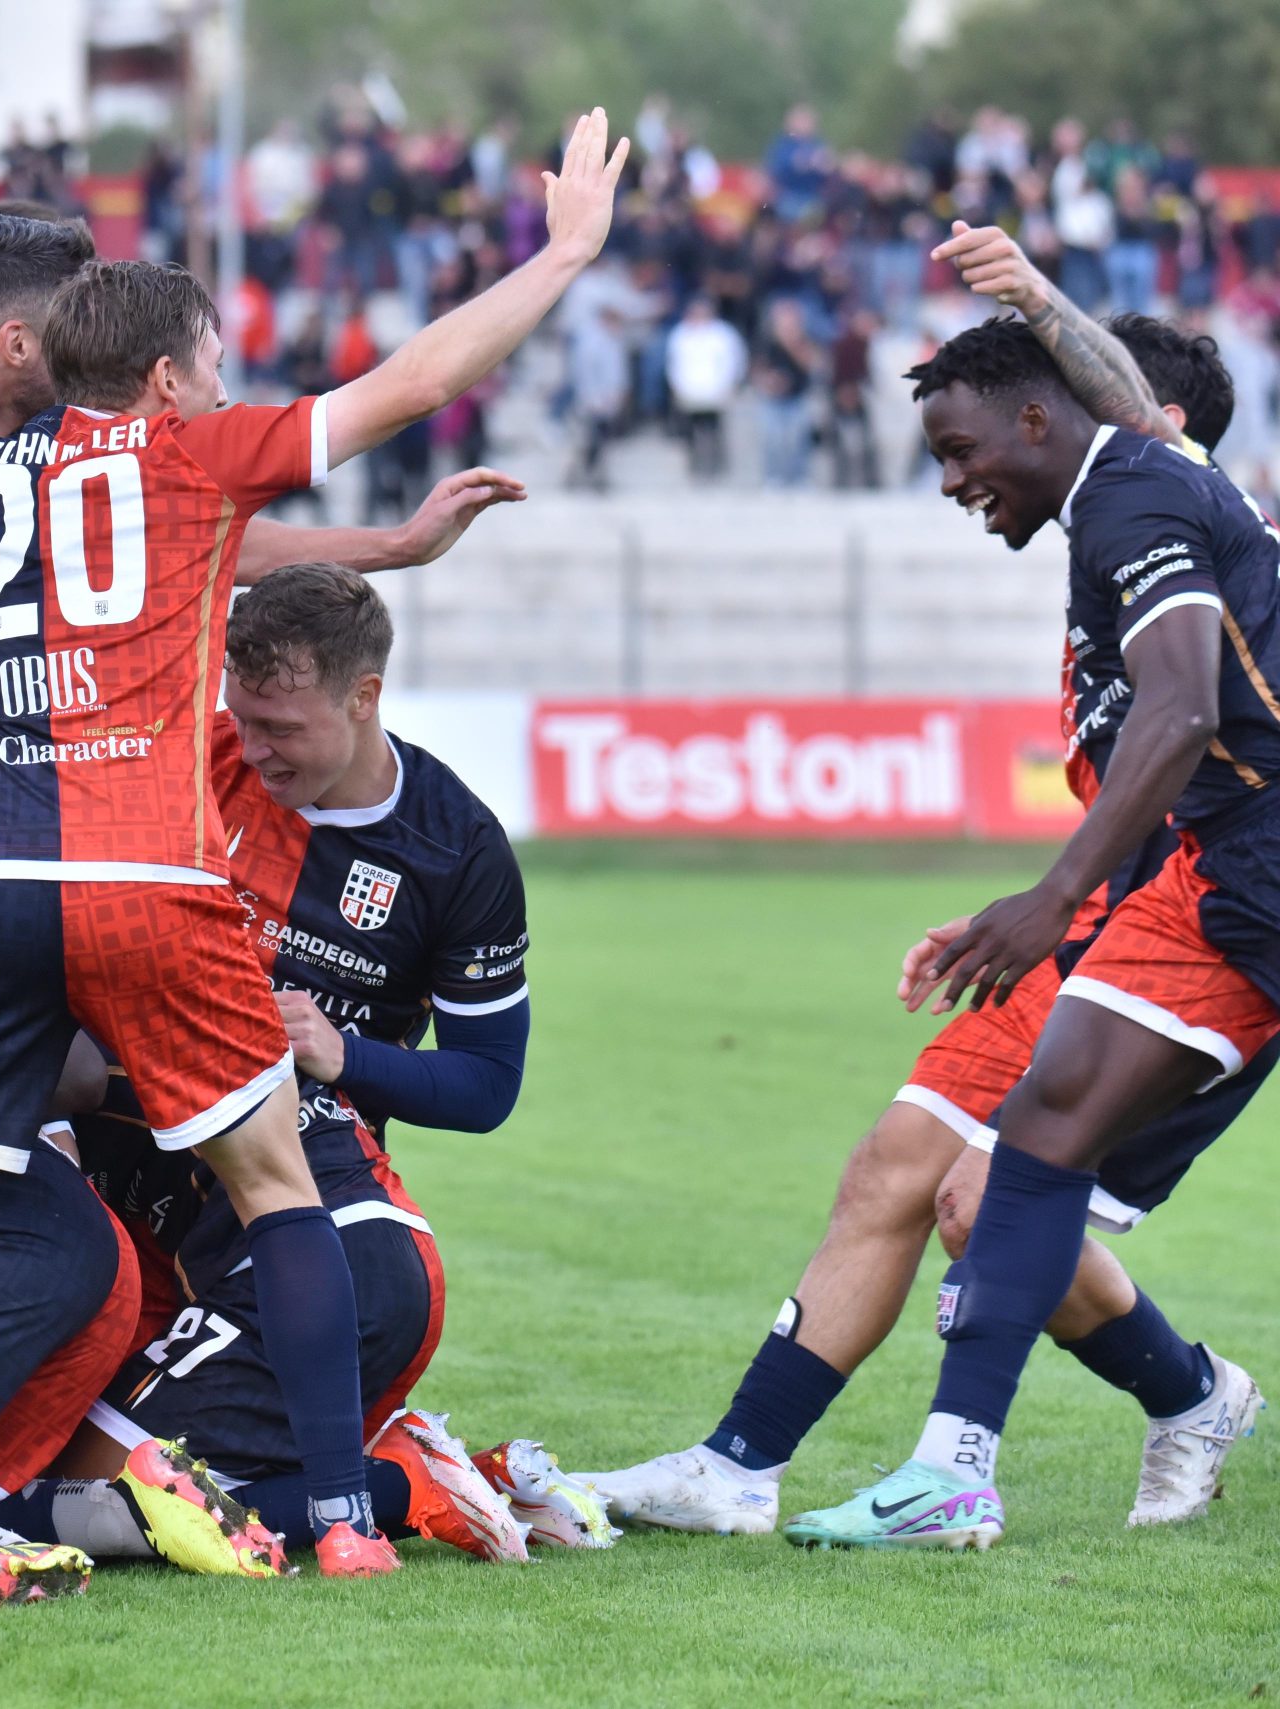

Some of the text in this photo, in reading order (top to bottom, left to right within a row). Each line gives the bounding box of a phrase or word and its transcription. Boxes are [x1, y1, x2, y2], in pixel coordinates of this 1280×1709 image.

[1133, 558, 1194, 596] abinsula
[86, 727, 107, 737] FEEL
[107, 726, 137, 736] GREEN
[539, 712, 964, 822] Testoni
[355, 863, 398, 886] TORRES
[257, 934, 293, 957] ISOLA
[295, 951, 385, 987] dell'Artigianato
[262, 918, 388, 979] SARDEGNA
[144, 1306, 242, 1379] 27
